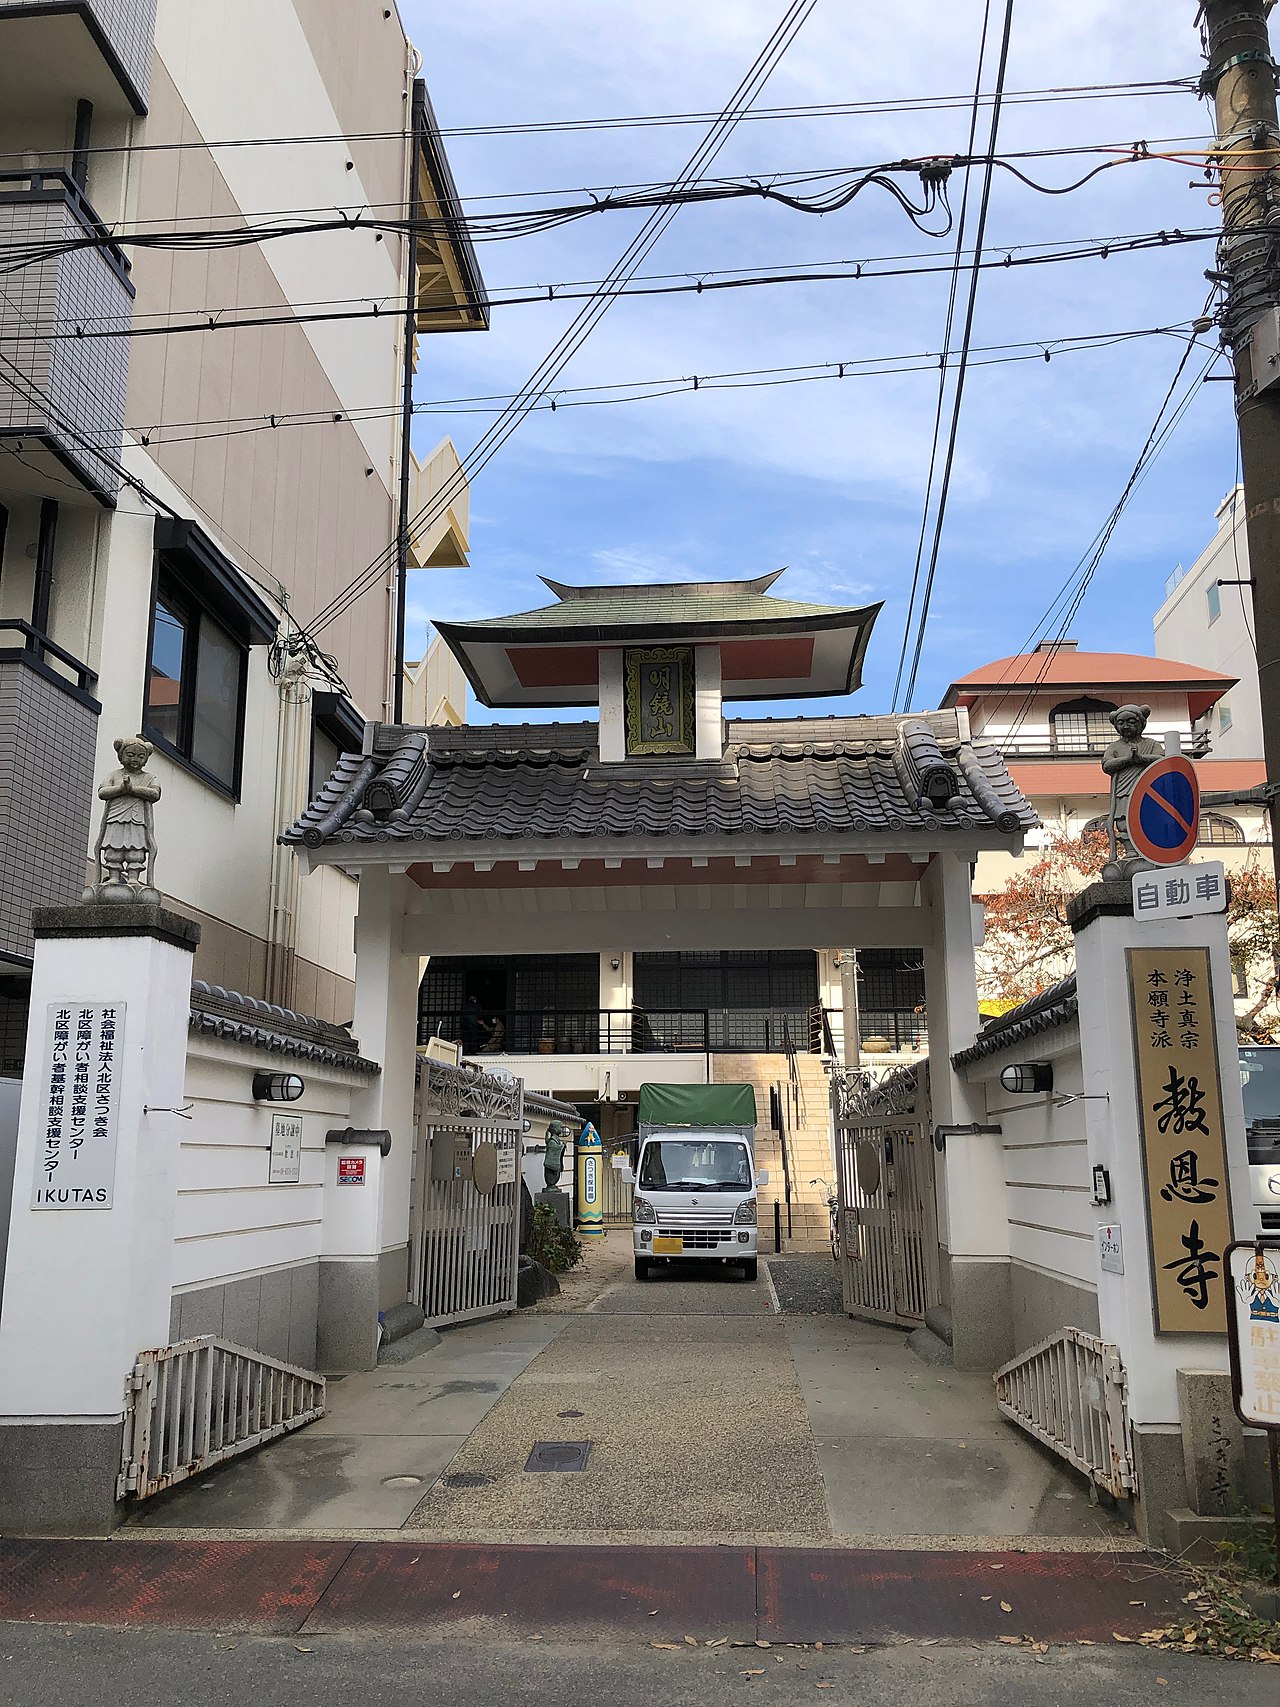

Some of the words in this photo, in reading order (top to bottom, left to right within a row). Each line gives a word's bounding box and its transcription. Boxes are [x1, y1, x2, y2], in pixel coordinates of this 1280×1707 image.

[649, 666, 674, 738] 明鏡山
[1137, 873, 1221, 910] 自動車
[1146, 968, 1173, 1049] 本願寺派
[1174, 968, 1200, 1049] 浄土真宗
[44, 1008, 71, 1183] 北区障がい者基幹相談支援センター
[69, 1008, 94, 1160] 北区障がい者相談支援センター
[92, 1008, 117, 1138] 社会福祉法人北区さつき会
[37, 1188, 107, 1203] IKUTAS
